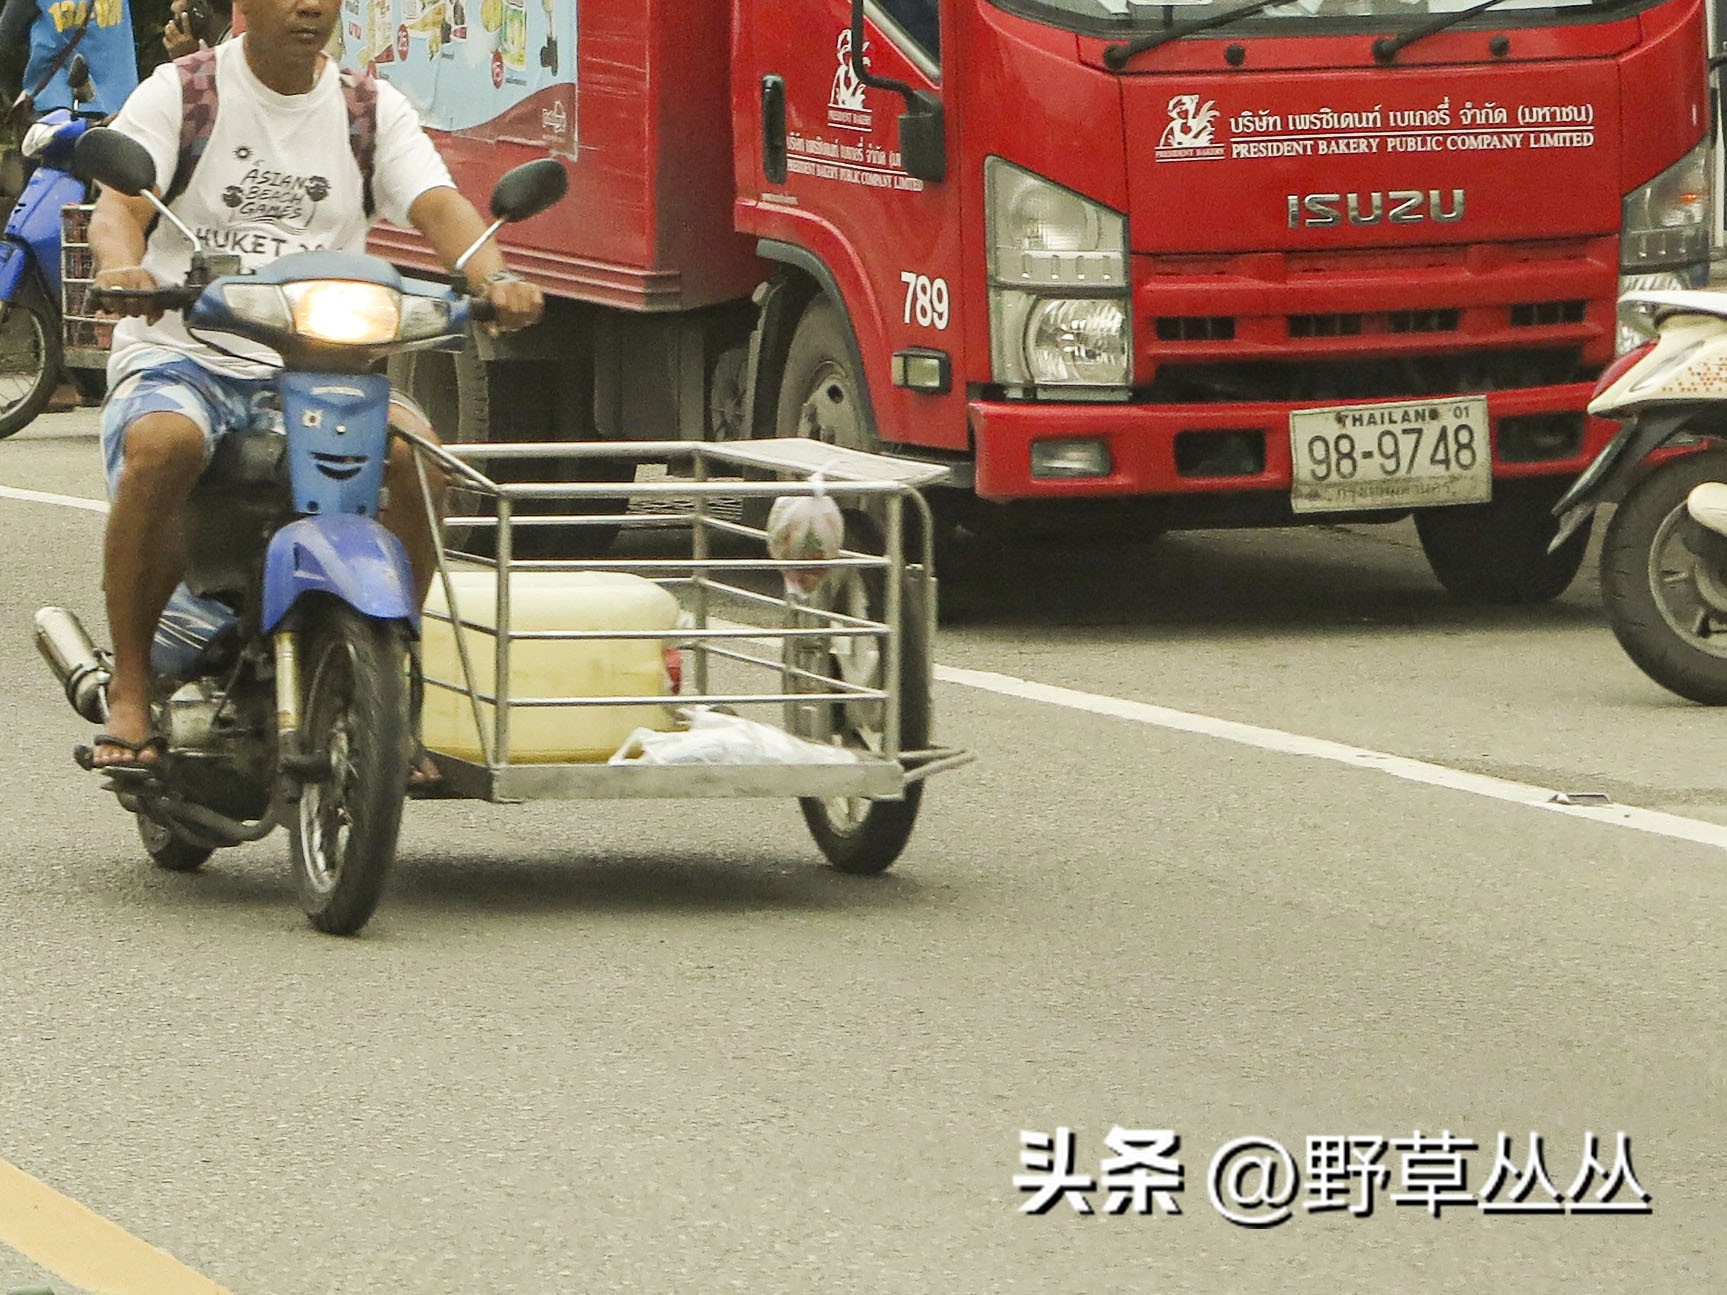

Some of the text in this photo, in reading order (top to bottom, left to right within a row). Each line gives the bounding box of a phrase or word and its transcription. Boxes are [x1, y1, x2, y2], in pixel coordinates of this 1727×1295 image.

[1230, 110, 1281, 133] บริษัท
[1389, 96, 1451, 127] เบเกอรี่
[1460, 102, 1507, 125] จำกัด
[1518, 103, 1593, 126] (มหาชน)
[1232, 131, 1594, 159] PRESIDENT BAKERY PUBLIC COMPANY LIMITED
[239, 202, 302, 219] GAMES
[1287, 187, 1465, 229] ISUZU
[195, 227, 287, 257] HUKET
[900, 270, 950, 330] 789
[1453, 405, 1471, 420] 01
[1308, 423, 1477, 482] 98-9748
